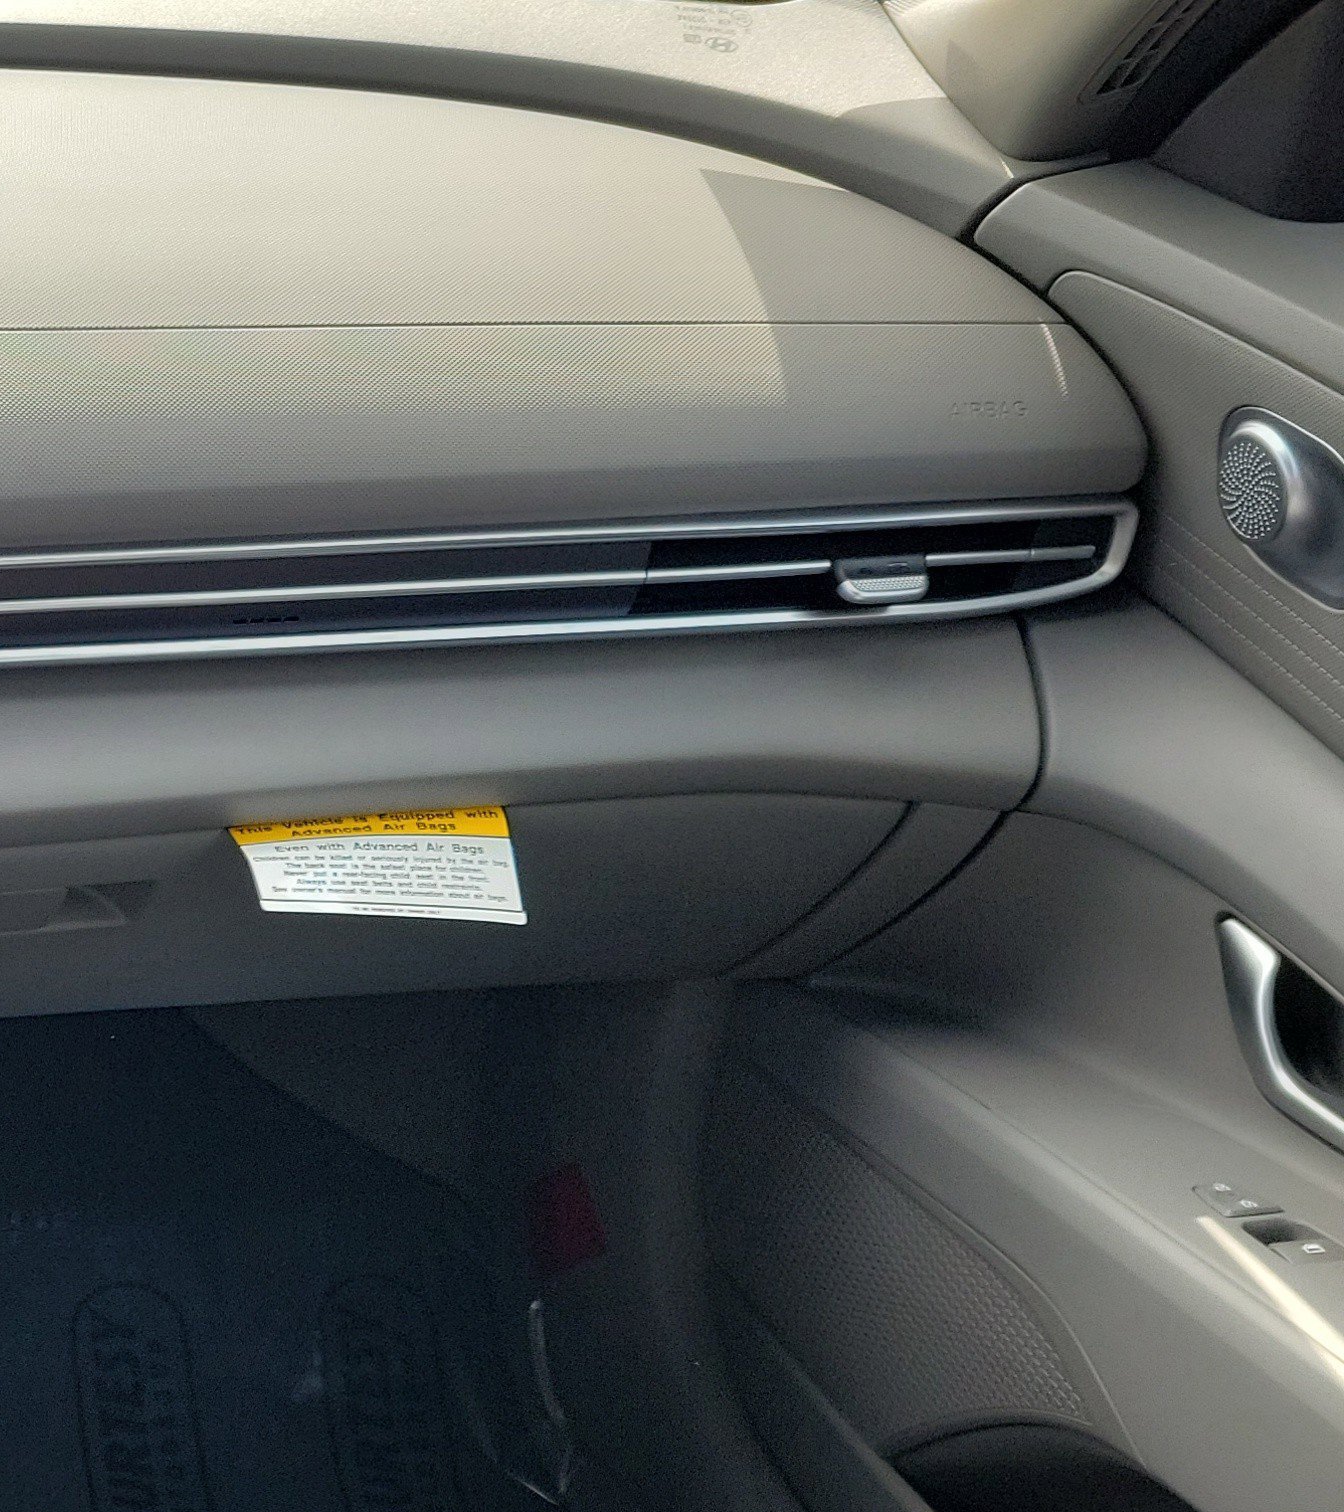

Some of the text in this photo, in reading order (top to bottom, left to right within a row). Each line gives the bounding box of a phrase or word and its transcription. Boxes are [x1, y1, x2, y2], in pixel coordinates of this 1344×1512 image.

[378, 811, 455, 823] Equipped
[465, 809, 499, 819] with
[292, 821, 457, 837] Advanced Air Bags
[274, 843, 485, 856] Even with Advanced Air Bags
